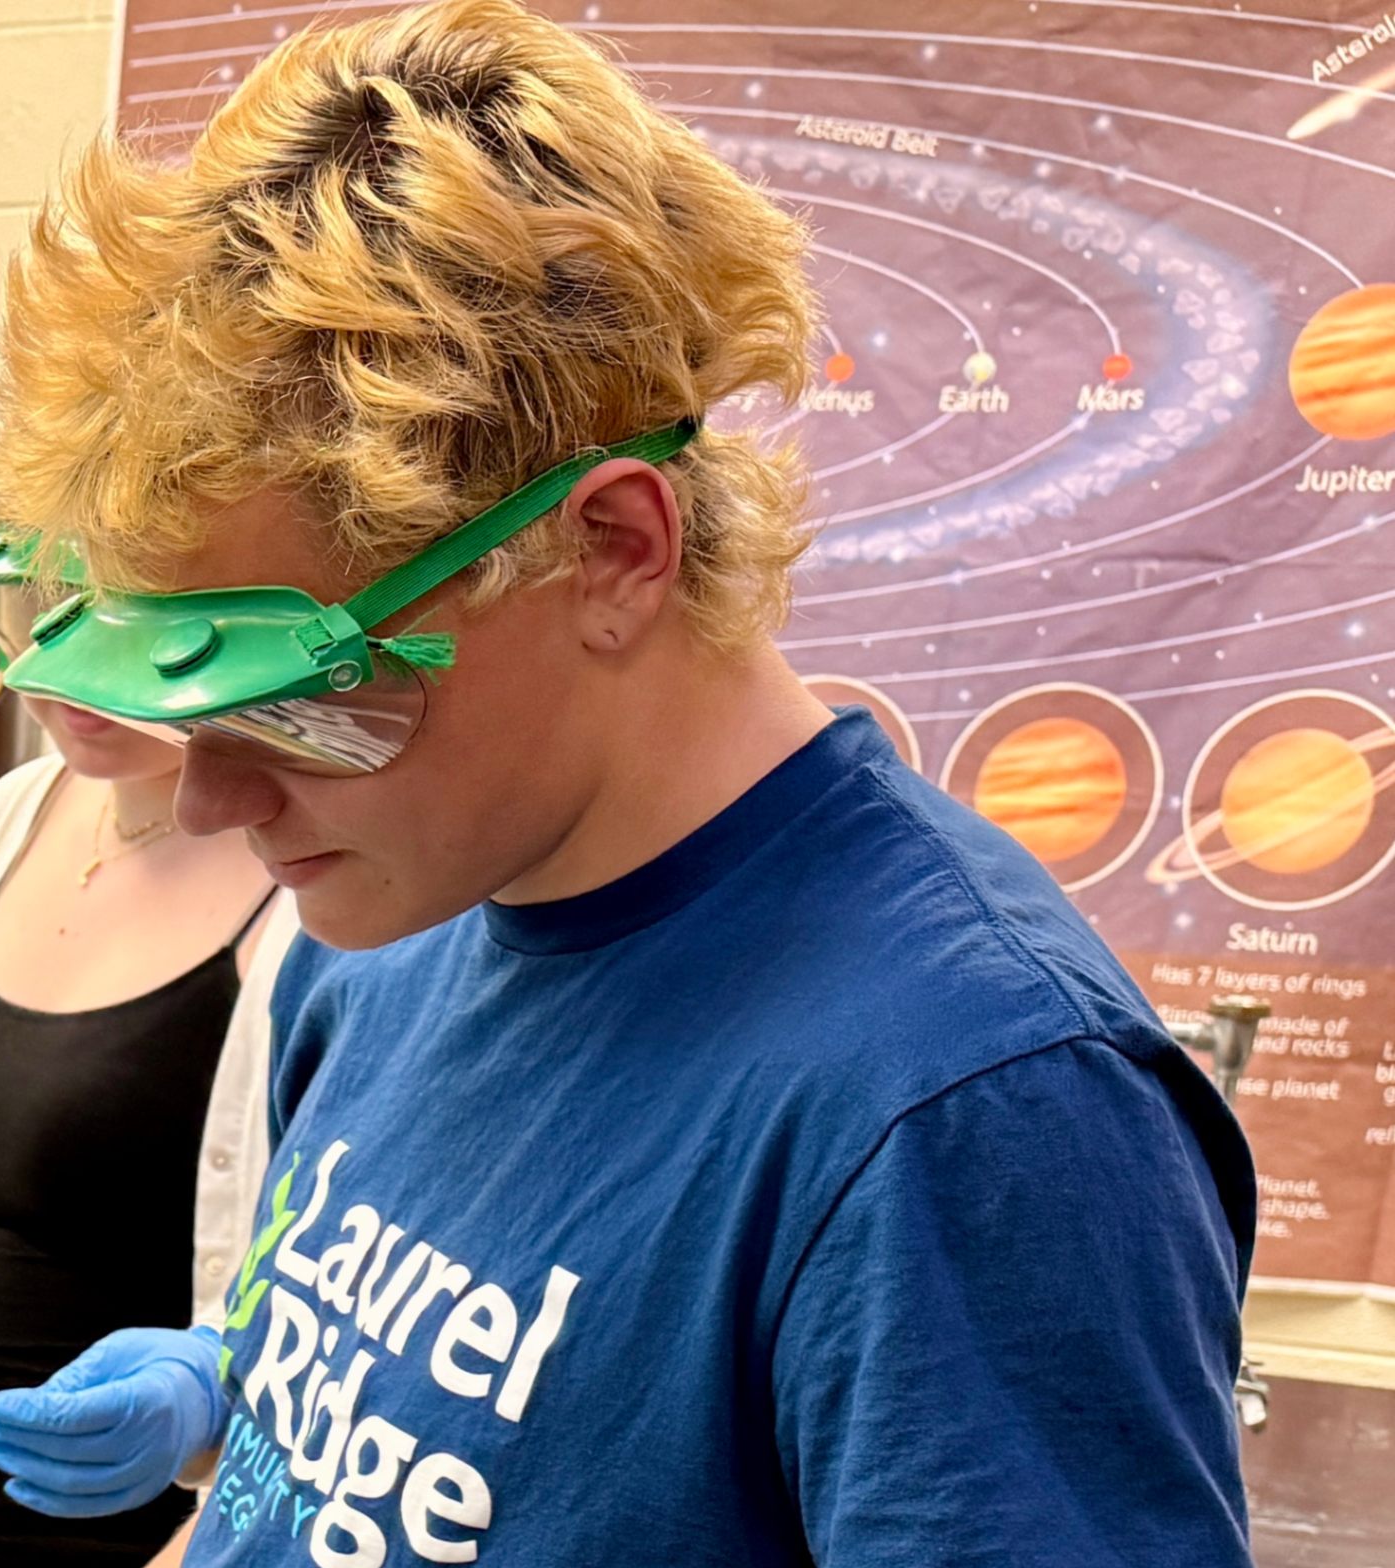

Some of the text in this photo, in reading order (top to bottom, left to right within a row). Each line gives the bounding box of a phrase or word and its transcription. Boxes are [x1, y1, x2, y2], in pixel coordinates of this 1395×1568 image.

[1312, 12, 1395, 86] Asteroi
[795, 114, 939, 158] Asteroid Belt
[939, 385, 1010, 414] Earth
[1077, 385, 1144, 412] Mars
[1296, 465, 1395, 495] Jupiter
[1226, 922, 1319, 956] Saturn
[1151, 963, 1367, 1000] Has 7 layers of rings
[1258, 1015, 1321, 1036] made
[1323, 1016, 1351, 1039] of
[1291, 1037, 1351, 1059] rocks
[1271, 1076, 1341, 1100] planet
[1261, 1198, 1331, 1222] shape.
[274, 1140, 582, 1424] Laurel
